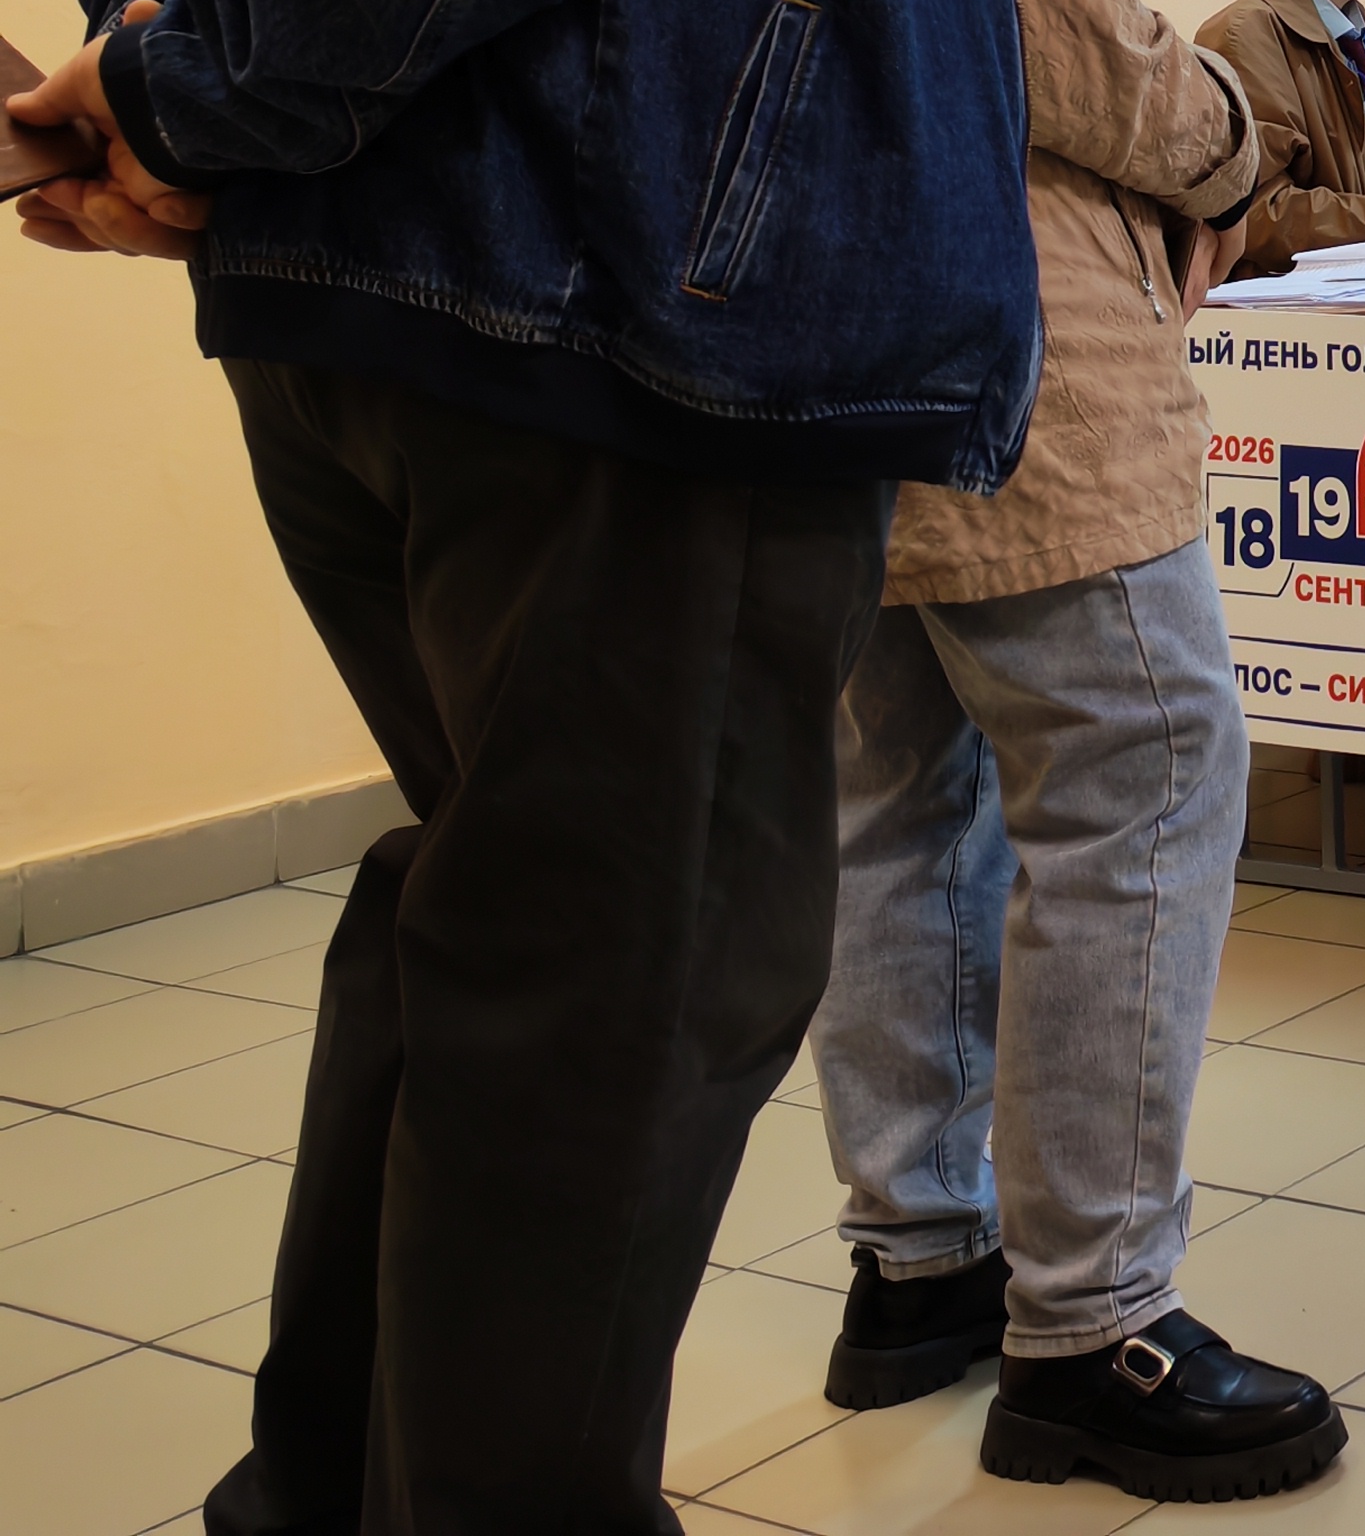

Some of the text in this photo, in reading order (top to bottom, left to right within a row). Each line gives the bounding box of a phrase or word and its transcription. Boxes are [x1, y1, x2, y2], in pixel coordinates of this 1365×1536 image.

[1184, 331, 1233, 365] ЫЙ
[1241, 339, 1318, 371] ДЕНЬ
[1208, 435, 1274, 464] 2026
[1289, 476, 1350, 539] 19
[1215, 507, 1275, 568] 18
[1233, 664, 1292, 695] ЛОС
